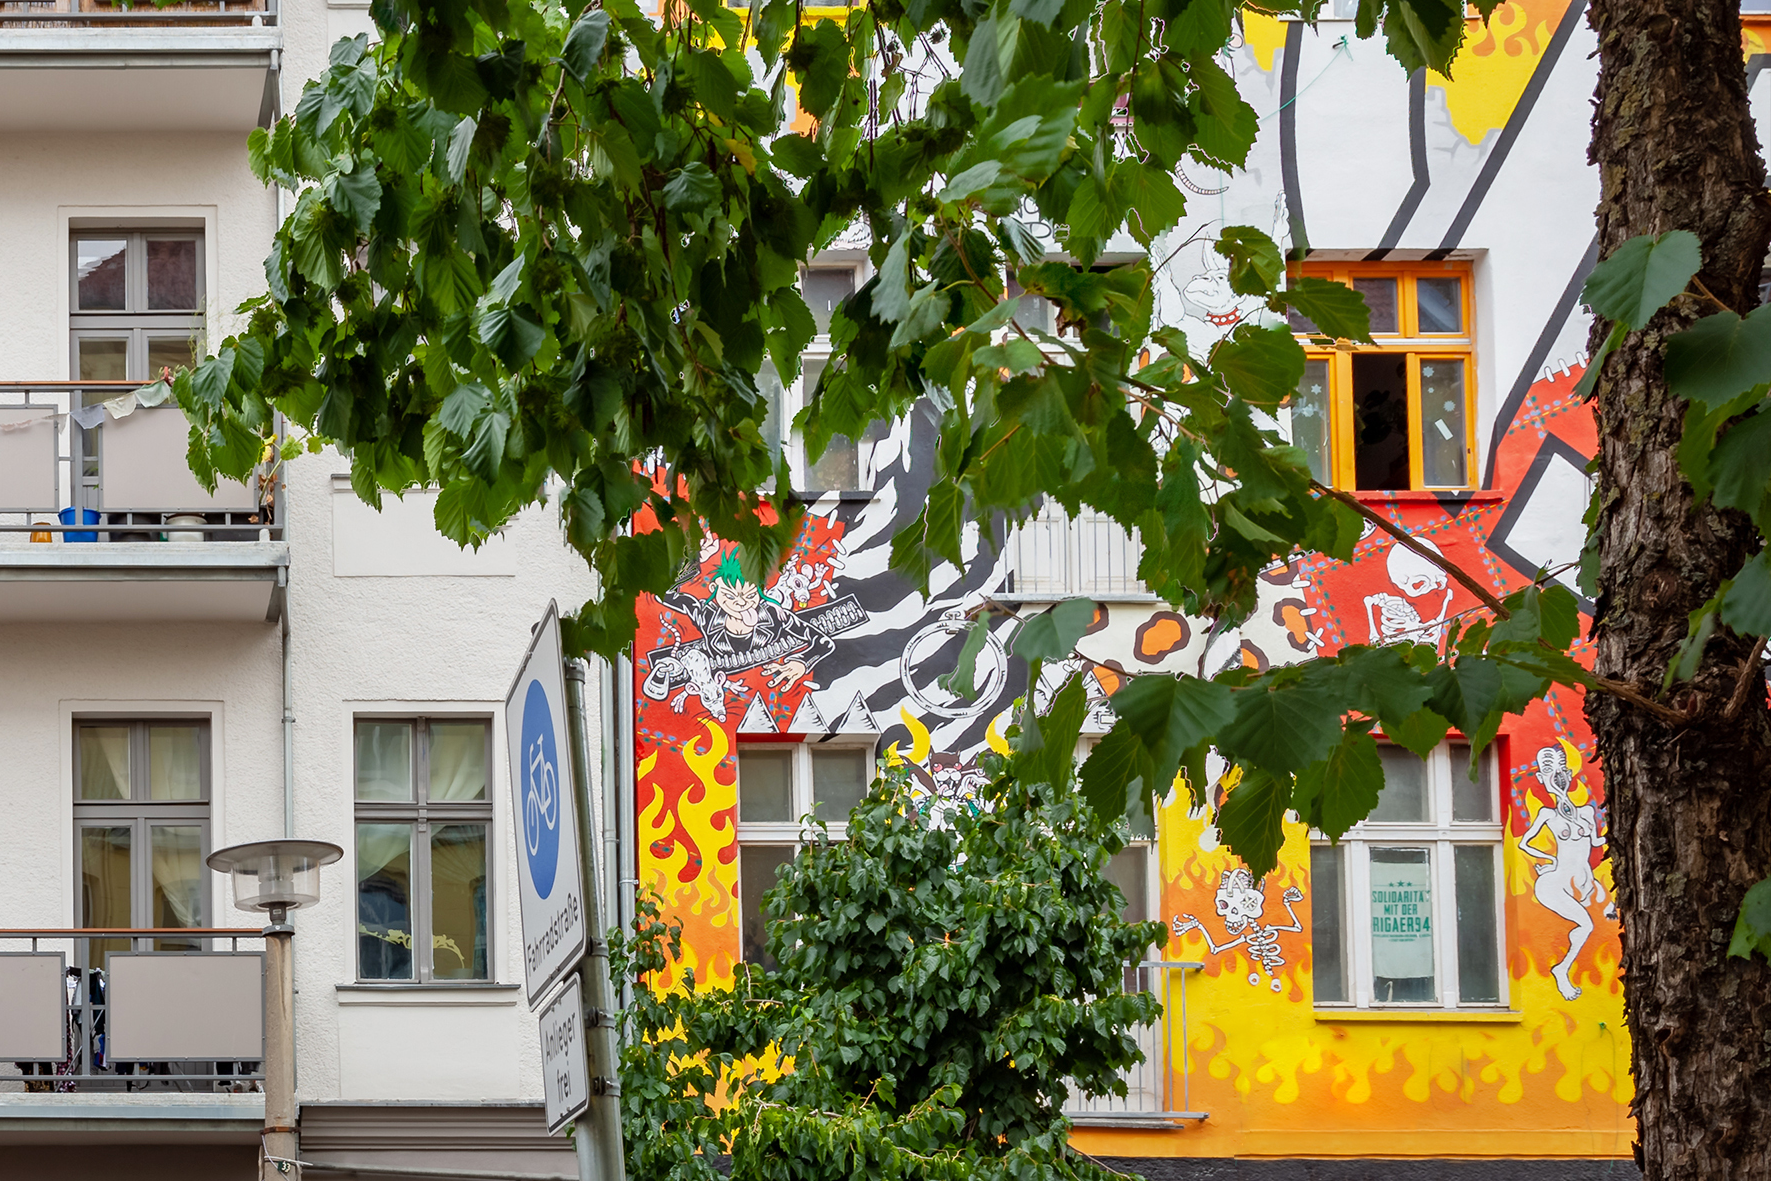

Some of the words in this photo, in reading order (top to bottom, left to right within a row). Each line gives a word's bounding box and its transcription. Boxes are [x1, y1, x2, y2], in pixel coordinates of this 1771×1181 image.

[1383, 903, 1399, 916] MIT
[1401, 903, 1418, 916] DER
[527, 892, 579, 978] Fahrradstraße
[545, 1011, 576, 1066] Anlieger
[556, 1060, 572, 1104] frei
